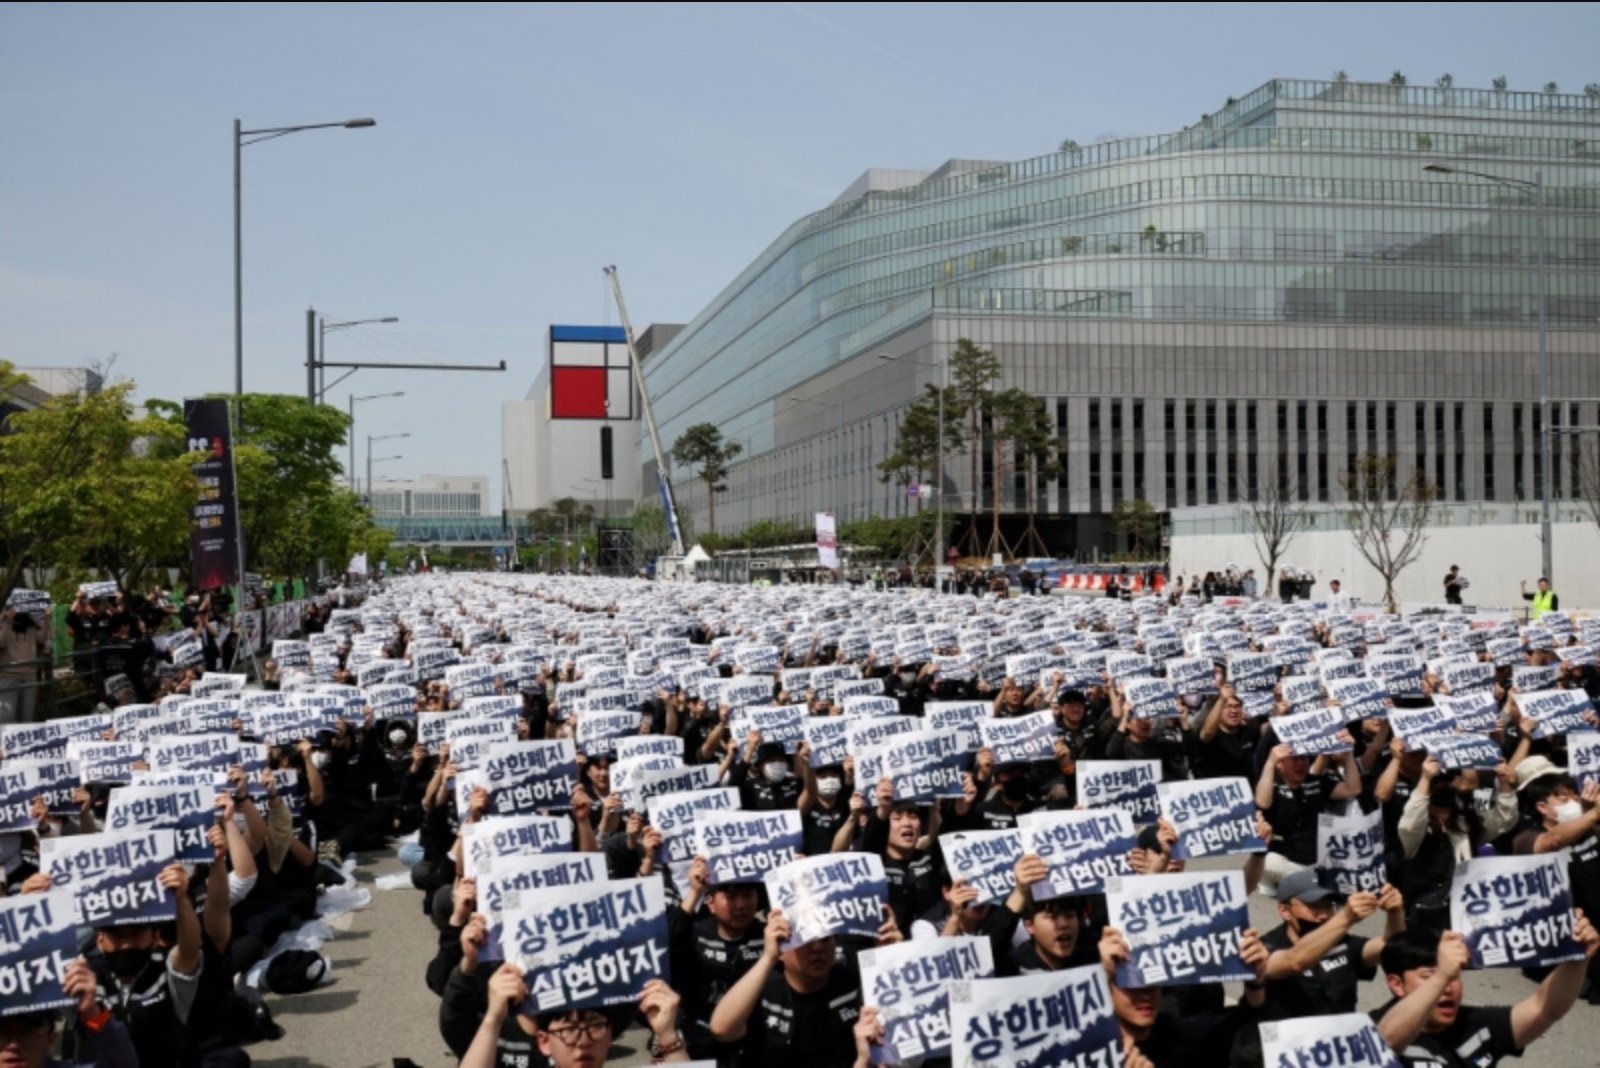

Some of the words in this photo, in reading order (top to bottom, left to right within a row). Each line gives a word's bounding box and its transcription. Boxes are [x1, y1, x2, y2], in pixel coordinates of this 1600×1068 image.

[1371, 657, 1415, 677] 상한폐지
[589, 692, 639, 711] 상한폐지
[1129, 681, 1171, 701] 상한폐지
[1524, 690, 1575, 716] 상한폐지
[581, 713, 634, 735] 상한폐지
[853, 718, 912, 747] 상한폐지
[931, 704, 986, 730] 상한폐지
[986, 713, 1044, 741] 상한폐지
[1279, 711, 1334, 738] 상한폐지
[1395, 709, 1445, 731] 상한폐지
[4, 726, 62, 750] 상한폐지
[81, 744, 133, 758] 한폐지
[156, 737, 228, 766] 상한폐지
[888, 733, 957, 769] 상한폐지
[1442, 745, 1495, 768] 실현하자
[486, 742, 565, 781] 상한폐지
[1083, 763, 1154, 798] 상한폐지
[496, 774, 576, 813] 실현하자
[897, 765, 964, 799] 실현하자
[112, 790, 201, 829] 상한폐지
[658, 790, 732, 830] 상한폐지
[1169, 781, 1244, 823] 상한폐지
[471, 821, 560, 860] 상한폐지
[702, 814, 789, 848] 상한폐지
[1031, 813, 1124, 857] 상한폐지
[1186, 816, 1258, 858] 실현하자
[51, 834, 157, 886] 상한폐지
[777, 856, 871, 909] 상한폐지
[1461, 858, 1564, 915] 상한폐지
[516, 883, 648, 954] 상한폐지
[800, 895, 886, 943] 현하자
[1120, 876, 1233, 933] 상한폐지
[1137, 926, 1242, 985] 실현하자
[1478, 908, 1576, 965] 실현하자
[0, 949, 72, 995] 하자
[531, 939, 669, 1011] 실현하자
[873, 942, 980, 1007] 상한폐지
[891, 1010, 951, 1060] 실현
[965, 972, 1105, 1061] 상한폐지
